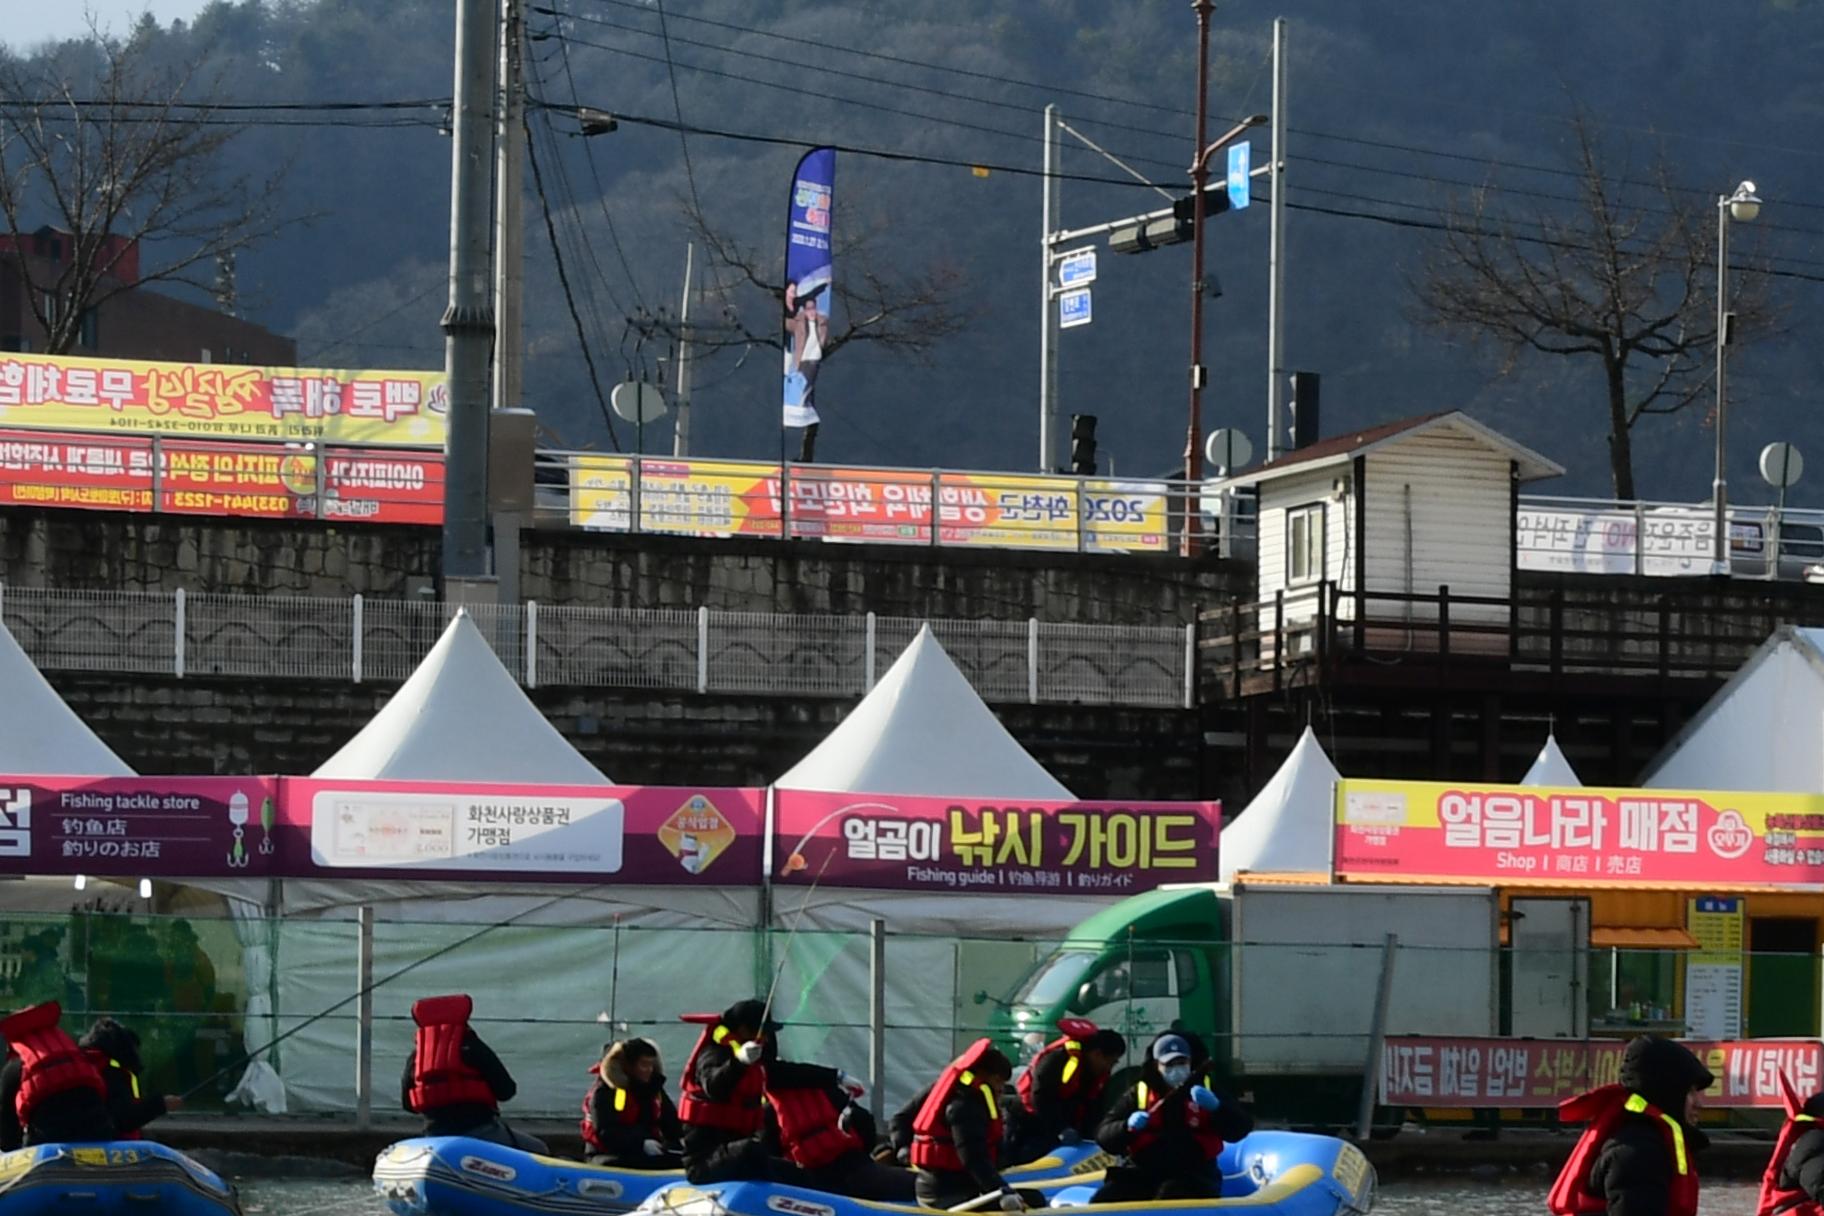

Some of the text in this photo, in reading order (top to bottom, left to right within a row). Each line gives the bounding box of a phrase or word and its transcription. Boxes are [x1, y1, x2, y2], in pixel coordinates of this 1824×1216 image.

[61, 794, 200, 813] Fishing tackle store
[466, 804, 572, 827] 화천사랑상품권
[1440, 794, 1699, 853] 얼음나라 매점
[466, 827, 512, 847] 가맹점
[843, 808, 1199, 869] 얼곰이 낚시 가이드
[62, 840, 160, 860] 釣りのお店
[1496, 852, 1536, 873] Shop
[1556, 855, 1588, 873] 商店
[1606, 856, 1642, 875] 売店
[906, 865, 996, 887] Fishing guide
